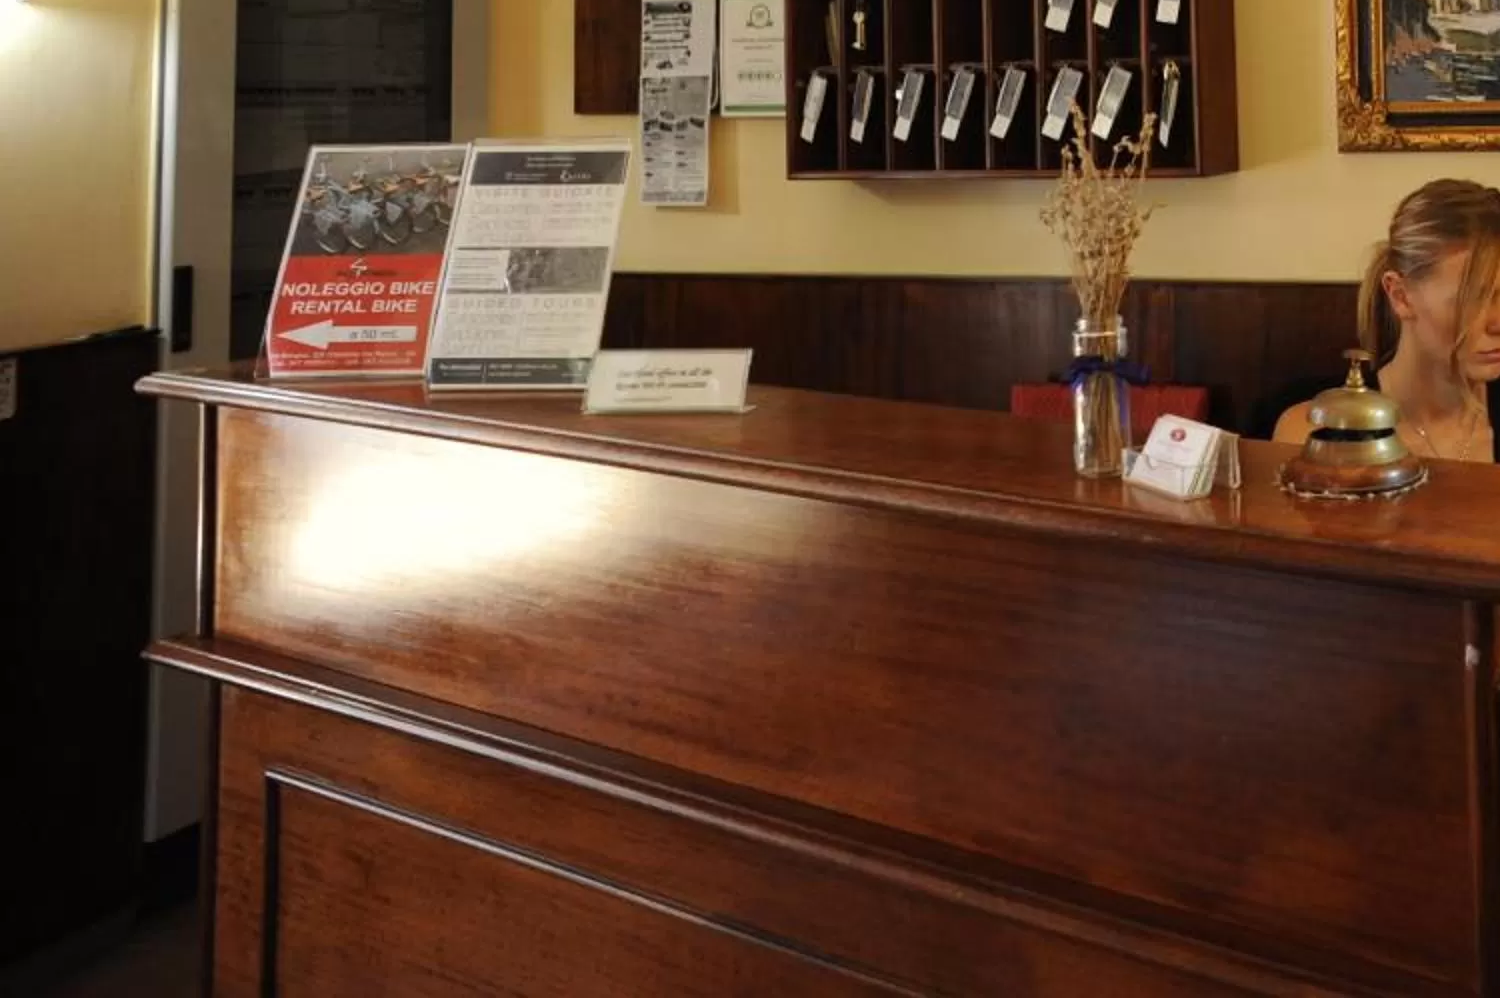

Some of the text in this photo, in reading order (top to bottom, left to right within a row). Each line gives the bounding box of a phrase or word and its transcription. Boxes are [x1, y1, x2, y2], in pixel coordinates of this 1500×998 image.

[281, 281, 436, 297] NOLEGGIO BIKE
[290, 299, 417, 315] RENTAL BIKE
